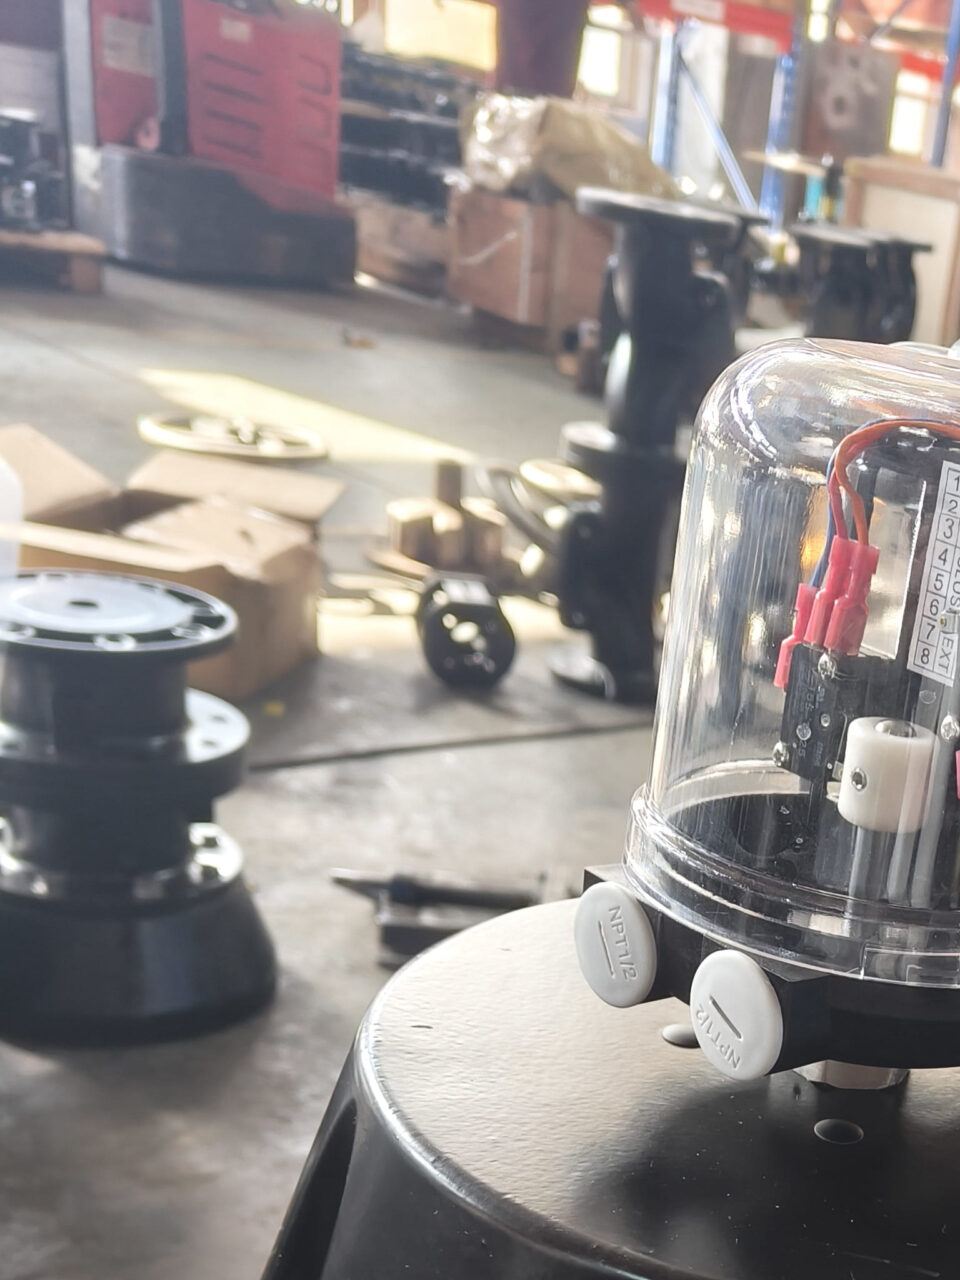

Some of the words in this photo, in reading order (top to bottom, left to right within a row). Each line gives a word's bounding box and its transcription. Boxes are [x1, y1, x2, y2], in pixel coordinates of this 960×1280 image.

[948, 501, 959, 515] 2
[943, 518, 954, 538] 3
[938, 547, 949, 566] 4
[933, 575, 944, 591] 5
[929, 599, 940, 617] 6
[925, 622, 936, 641] 7
[920, 647, 930, 665] 8
[937, 637, 954, 674] EXT
[608, 905, 637, 981] NPT1/2
[695, 1003, 741, 1070] NPT1/2
